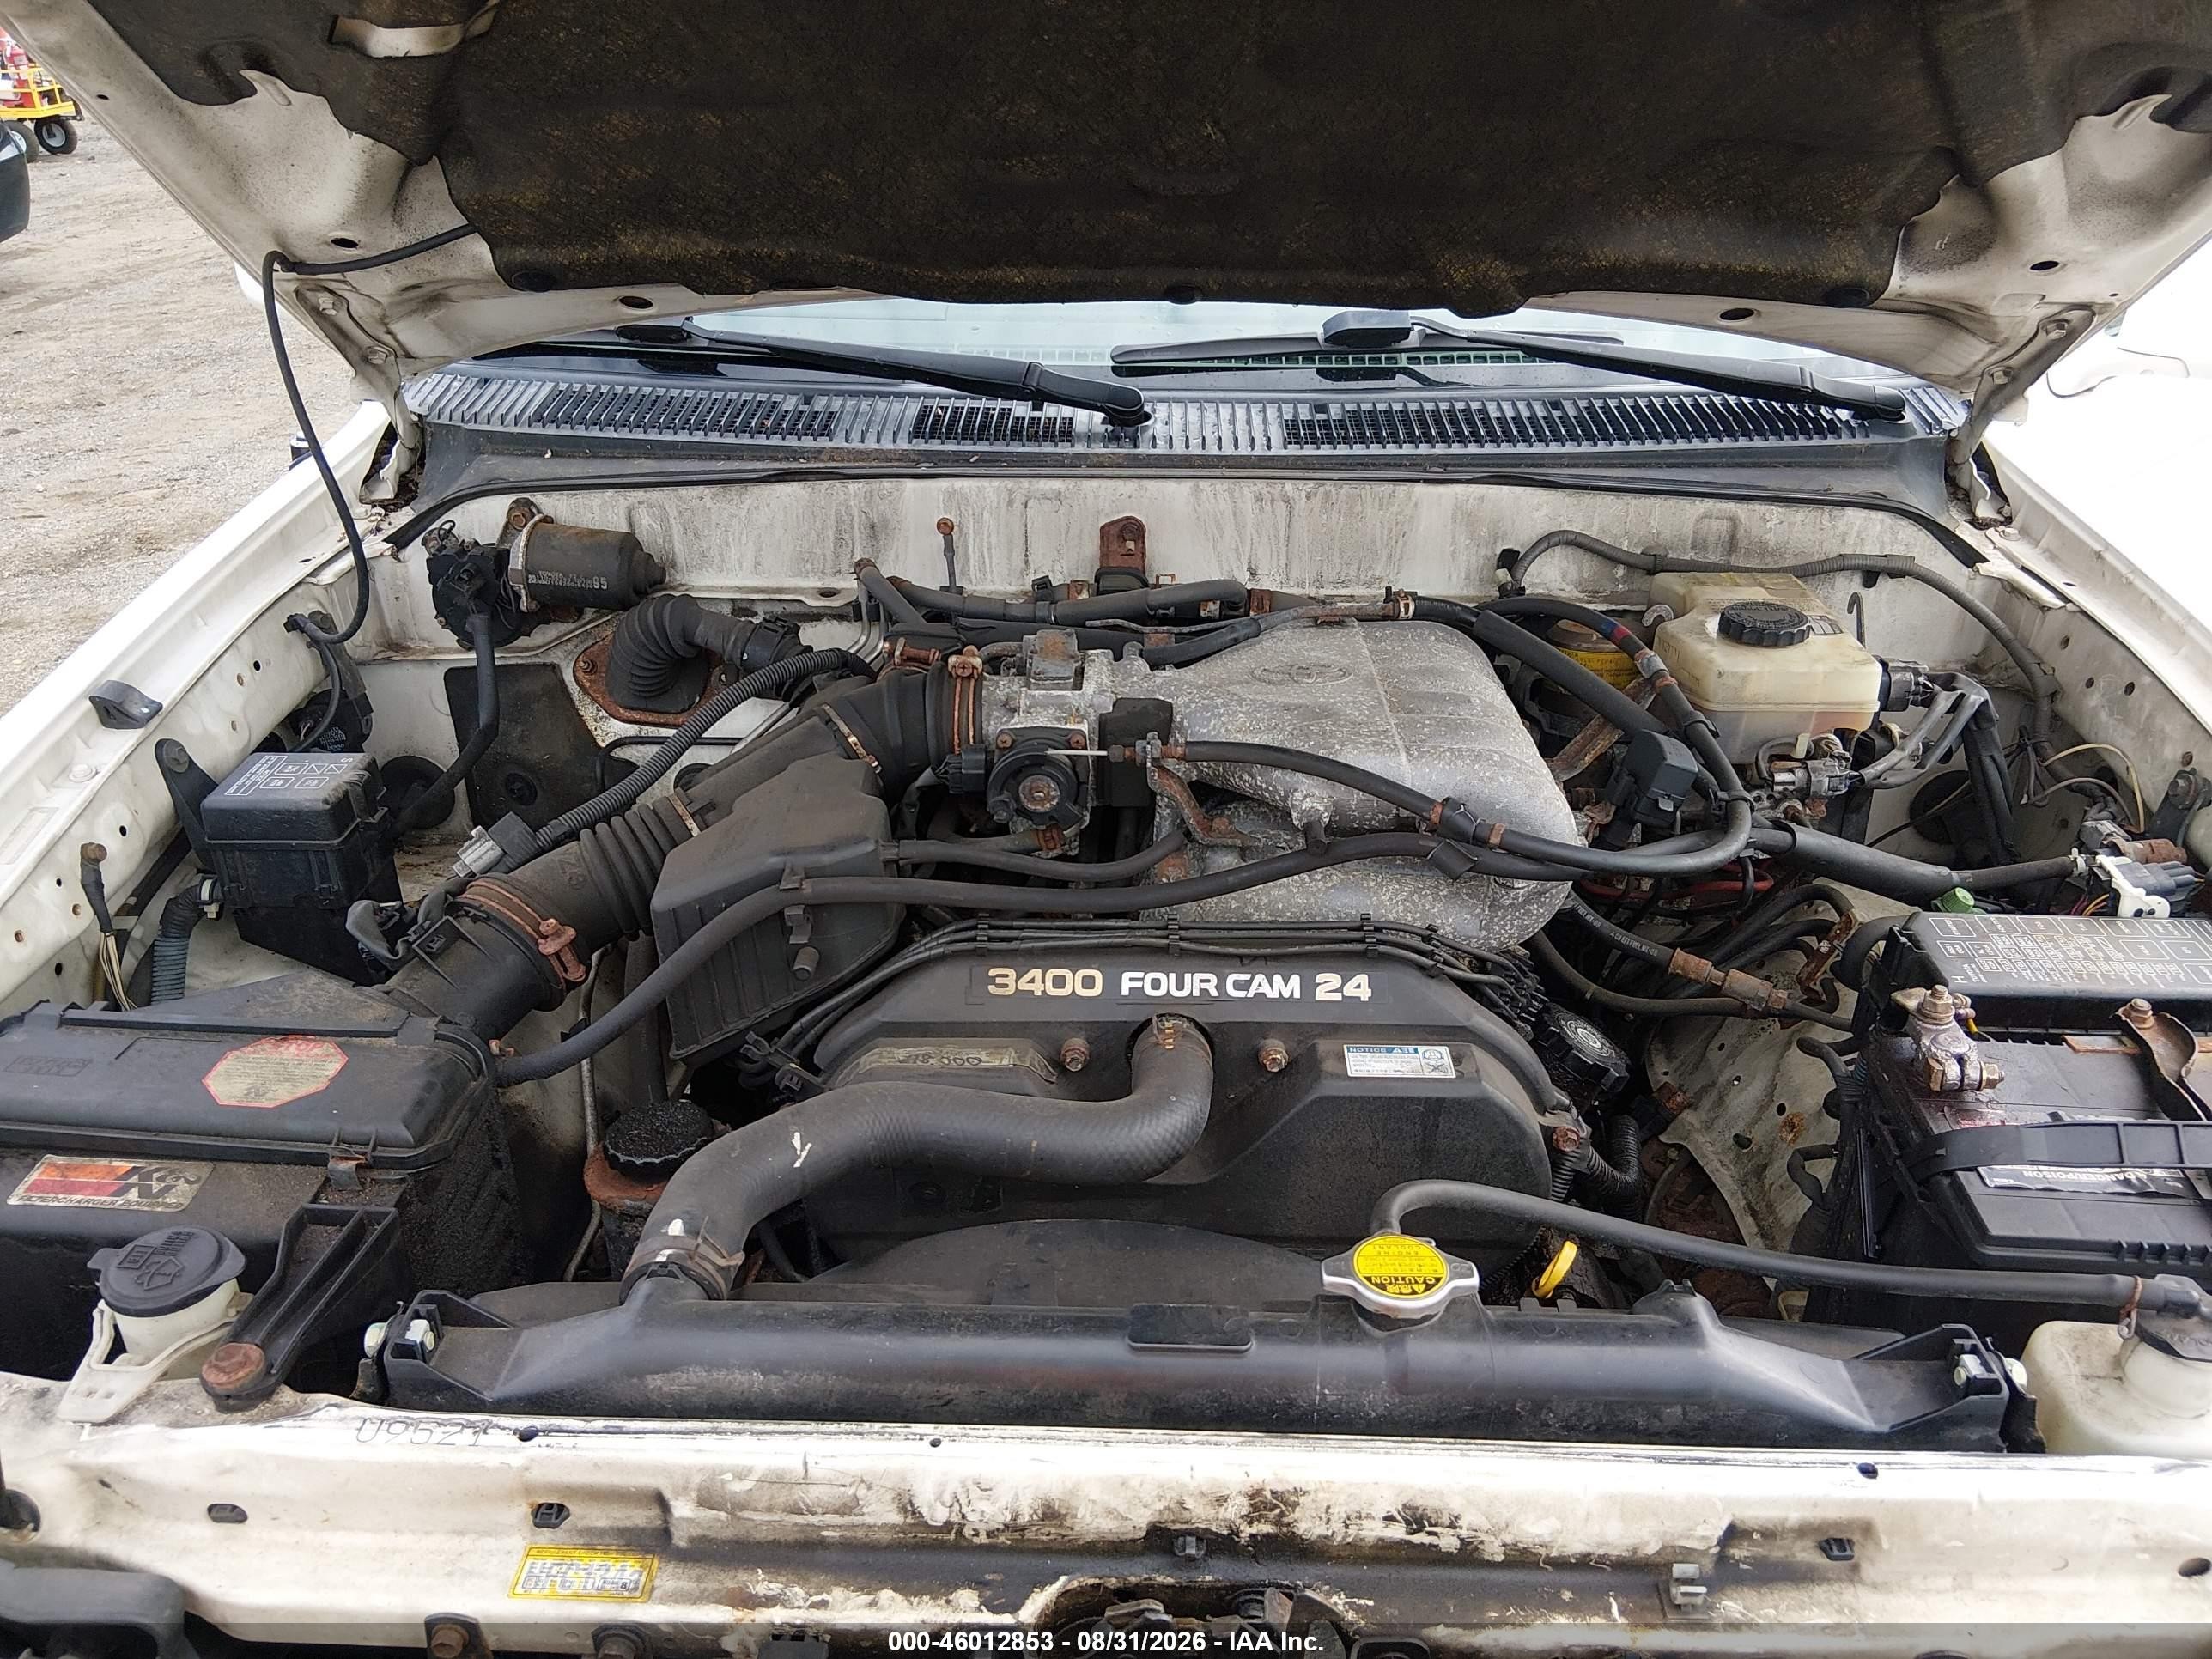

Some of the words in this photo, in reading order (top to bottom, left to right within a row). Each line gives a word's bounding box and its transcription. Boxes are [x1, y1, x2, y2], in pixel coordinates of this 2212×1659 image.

[988, 968, 1104, 997] 3400
[1120, 971, 1219, 998] FOUR
[1225, 973, 1302, 999] CAM
[1314, 973, 1372, 1002] 24
[1370, 1276, 1437, 1285] CAUTION
